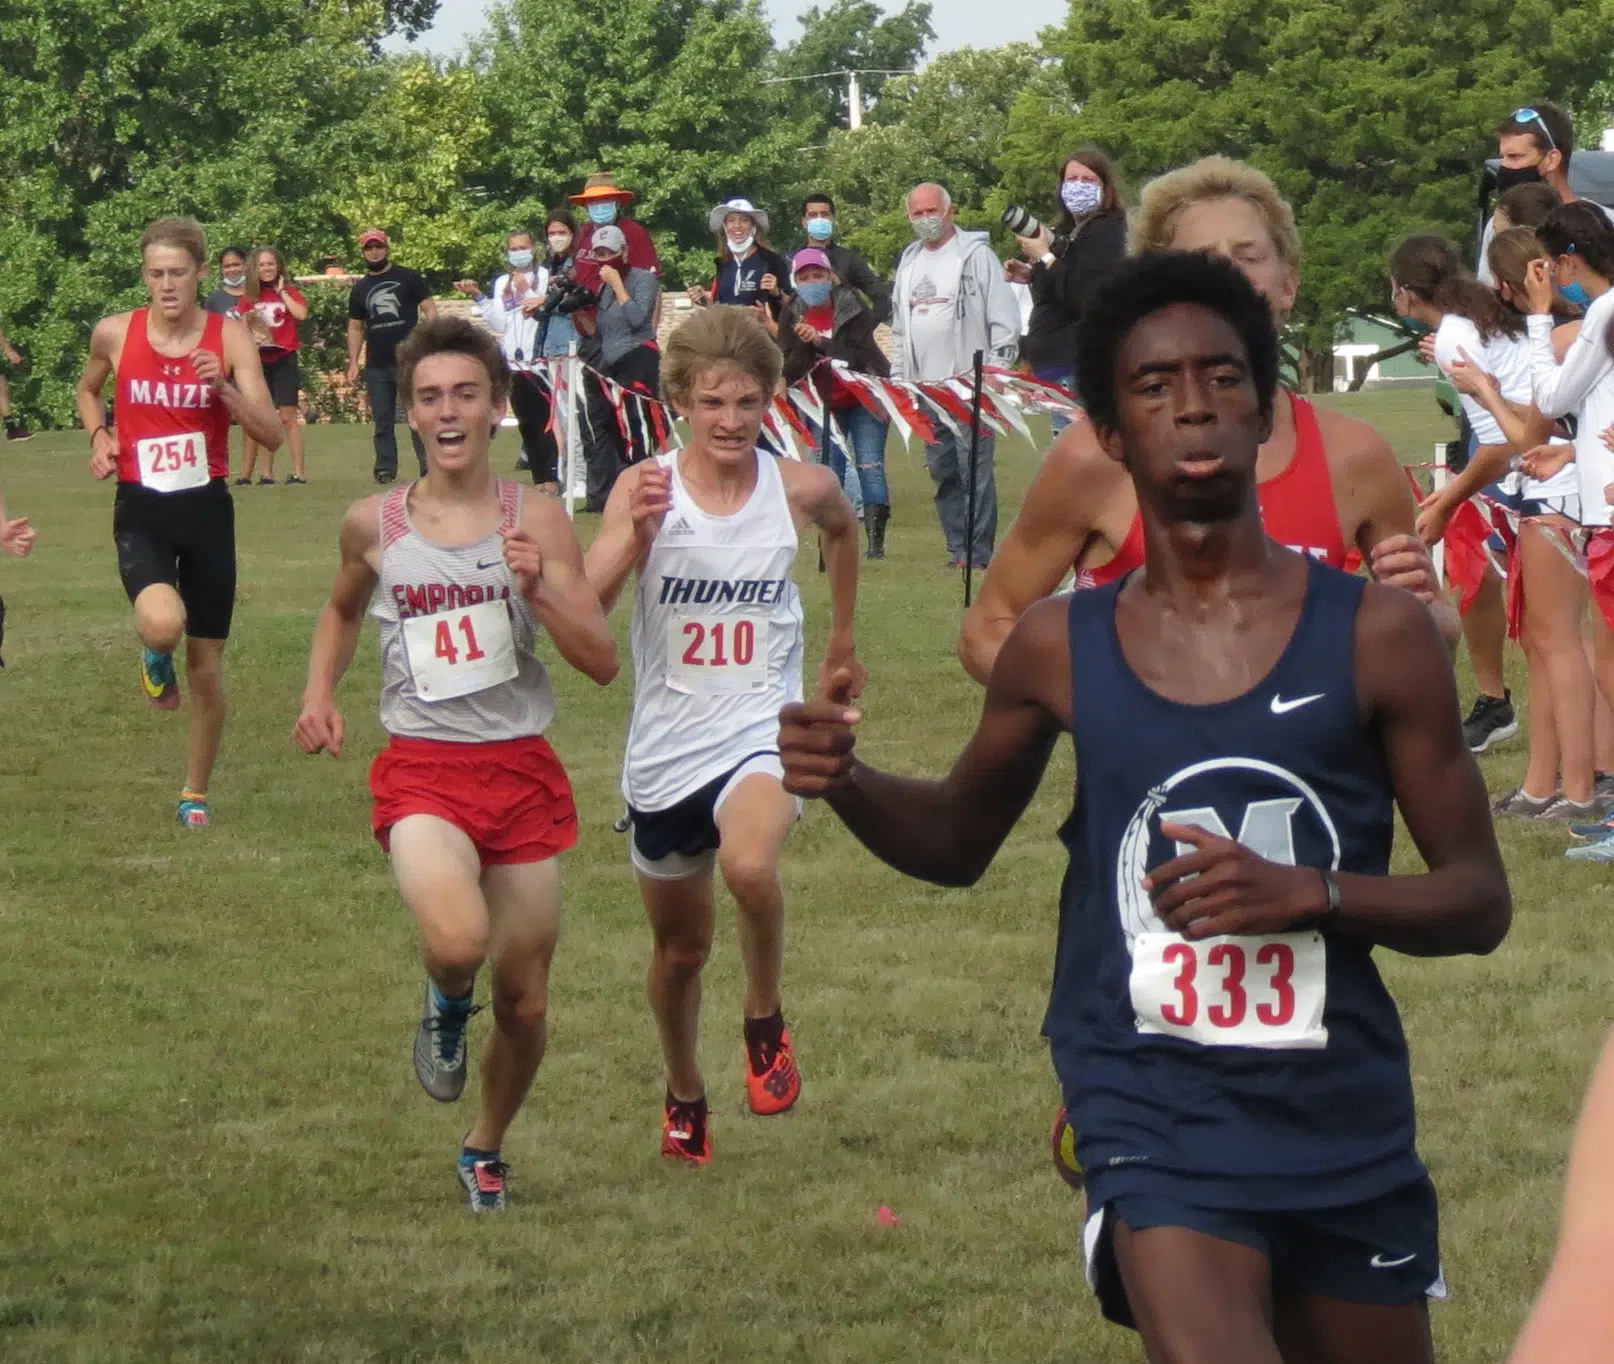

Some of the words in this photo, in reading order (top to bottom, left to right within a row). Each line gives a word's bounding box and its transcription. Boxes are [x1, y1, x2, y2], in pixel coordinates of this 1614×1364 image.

[130, 379, 212, 408] MAIZE
[148, 438, 197, 474] 254
[435, 614, 485, 665] 41
[682, 620, 754, 666] 210
[1160, 943, 1296, 1028] 333
